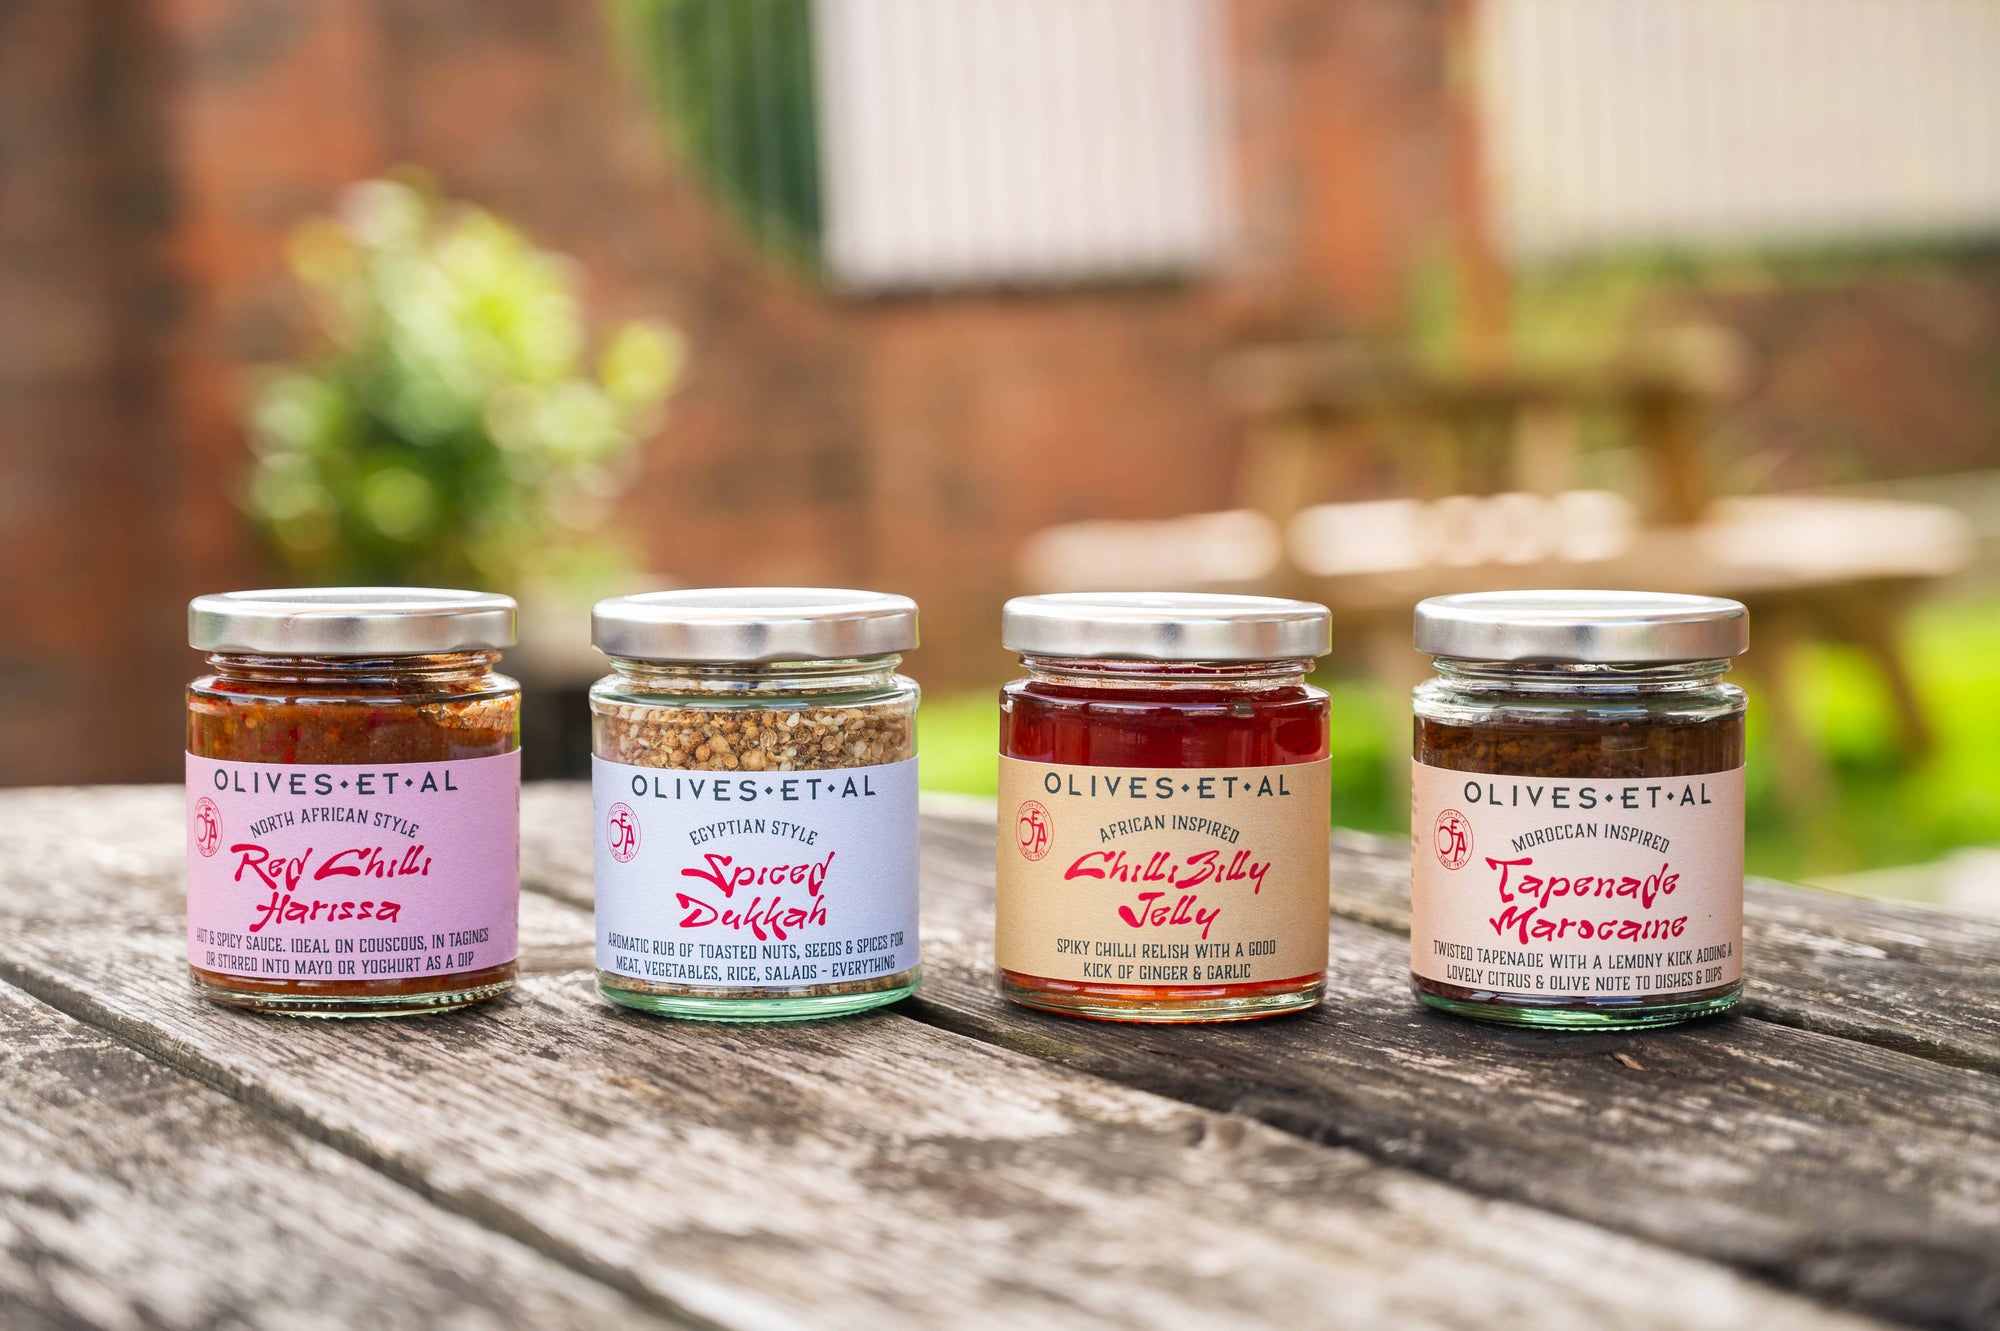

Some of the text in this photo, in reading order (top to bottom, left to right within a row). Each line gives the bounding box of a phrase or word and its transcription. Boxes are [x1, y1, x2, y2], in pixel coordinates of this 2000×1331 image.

[250, 807, 420, 839] NORTH AFRICAN STYLE
[689, 819, 818, 846] EGYPTIAN STYLE
[1099, 814, 1241, 844] AFRICAN INSPIRED
[1511, 822, 1671, 854] MOROCCAN INSPIRED
[230, 843, 432, 891] Red Chilli
[681, 851, 836, 898] Spiced
[1064, 850, 1272, 895] Chilli Billy
[1485, 856, 1680, 910] Tapenade
[249, 891, 401, 932] Harissa
[675, 892, 827, 942] Dukkah
[1118, 891, 1221, 940] Jelly
[1489, 905, 1688, 945] Marocaine
[209, 931, 215, 945] &
[217, 931, 242, 949] SPICY
[246, 935, 286, 953] SAUCE.
[291, 938, 330, 954] IDEAL
[335, 938, 354, 954] ON
[359, 935, 427, 953] COUSCOUS,
[432, 933, 445, 949] IN
[449, 927, 489, 947] TAGINES
[608, 931, 904, 960] AROMATIC RUB OF TOASTED NUTS, SEEDS & SPICES FOR
[1057, 938, 1276, 959] SPIKY CHILLI RELISH WITH A GOOD
[1433, 940, 1733, 969] TWISTED TAPENADE WITH A LEMONY KICK ADDING A
[206, 951, 474, 975] OR STIRRED INTO MAYO OR YOGHURT AS A DIP
[616, 955, 641, 975] MEAT,
[644, 960, 722, 982] VEGETABLES,
[727, 966, 760, 982] RICE,
[765, 965, 817, 981] SALADS
[832, 954, 895, 978] EVERYTHING
[1083, 962, 1251, 981] KICK OF GINGER & GARLIC
[1446, 964, 1722, 991] LOVELY CITRUS & OLIVE NOTE TO DISHES & DIPS
